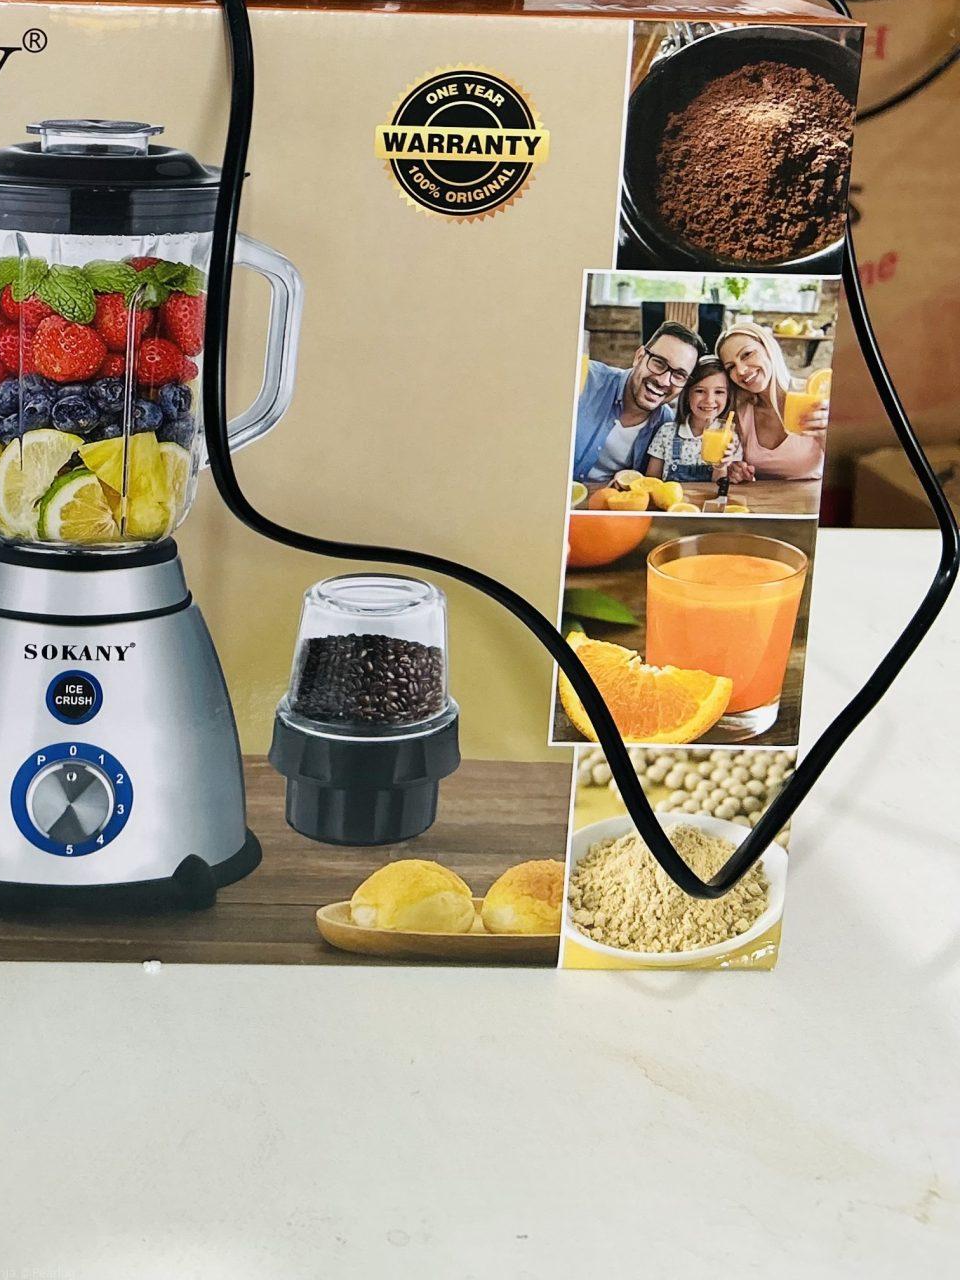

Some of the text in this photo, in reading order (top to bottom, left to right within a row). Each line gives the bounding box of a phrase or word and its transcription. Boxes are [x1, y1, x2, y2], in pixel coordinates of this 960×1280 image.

[426, 83, 506, 108] ONE YEAR
[383, 131, 542, 156] WARRANTY
[407, 165, 516, 204] 100% ORIGINAL
[64, 684, 84, 695] ICE
[54, 695, 93, 706] CRUSH
[69, 745, 78, 757] 0
[36, 755, 47, 766] P
[97, 754, 105, 765] 1
[115, 773, 125, 785] 2
[116, 803, 125, 815] 3
[95, 834, 105, 846] 4
[65, 844, 74, 856] 5
